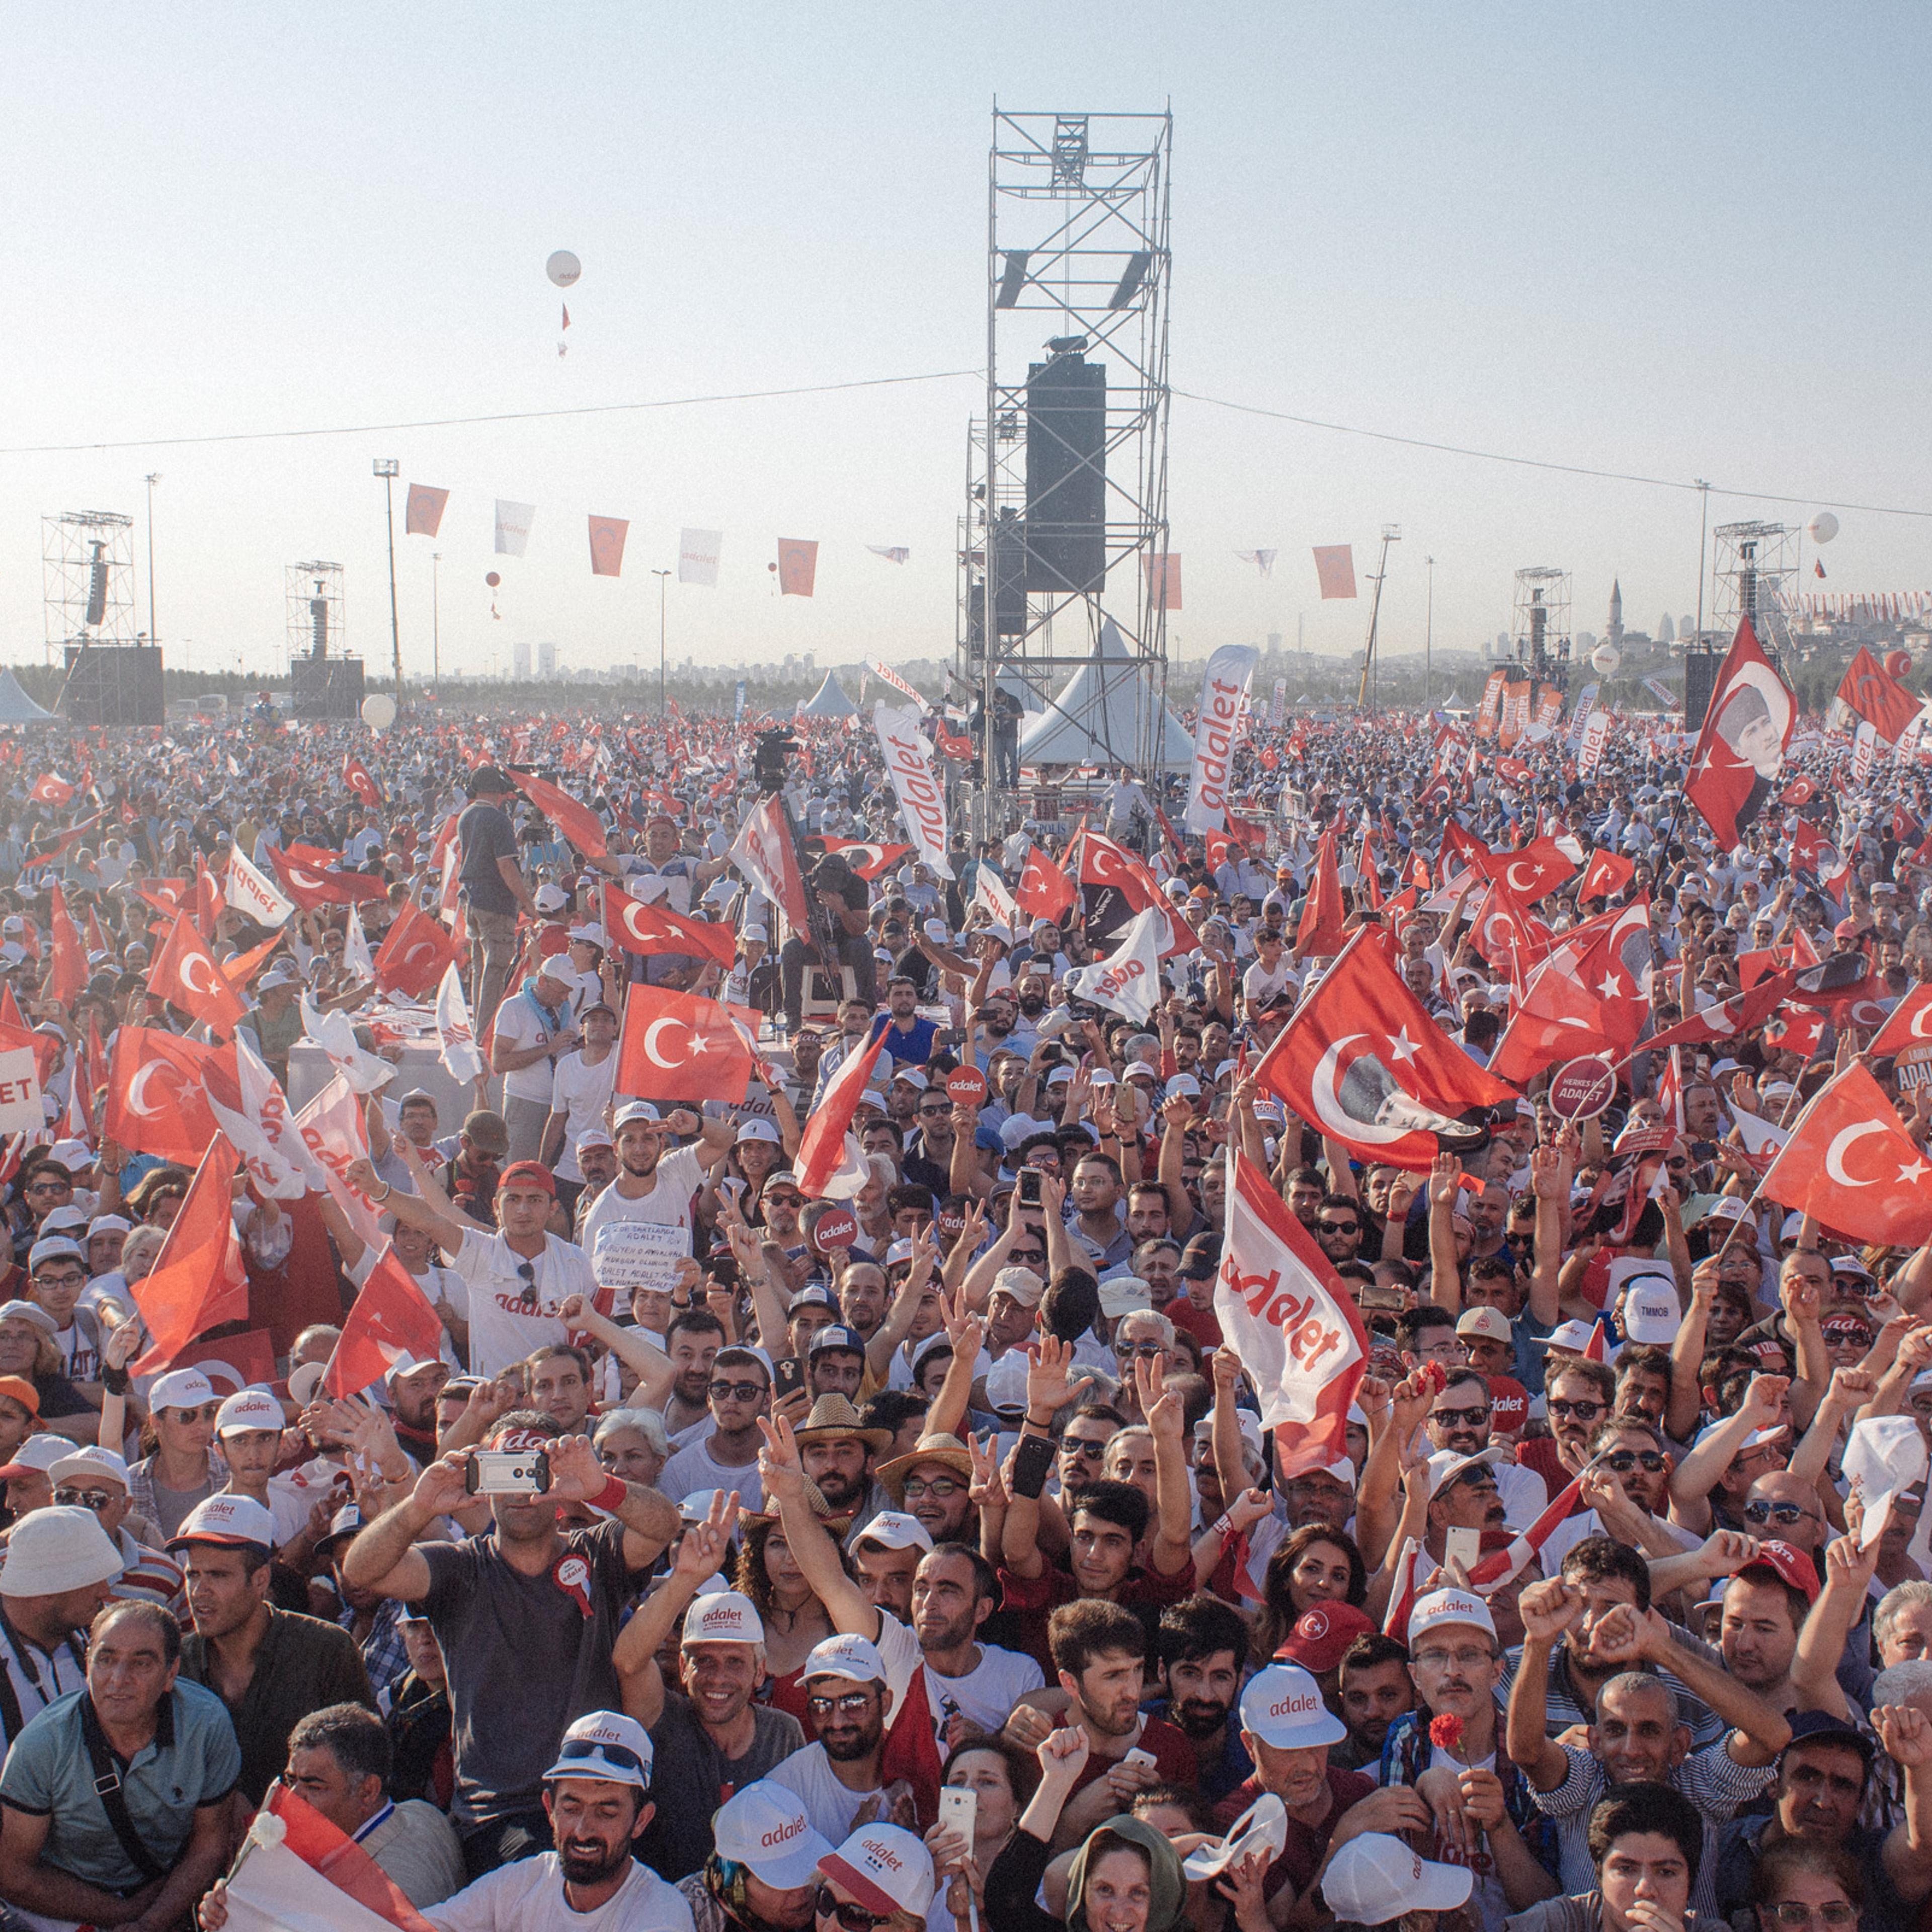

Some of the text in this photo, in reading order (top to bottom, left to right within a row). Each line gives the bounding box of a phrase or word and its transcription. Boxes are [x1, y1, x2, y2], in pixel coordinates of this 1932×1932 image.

[1482, 679, 1502, 717] adalet
[1572, 694, 1594, 740] adalet
[1578, 726, 1603, 772] dalet
[949, 1080, 983, 1092] adalet
[1562, 1078, 1591, 1087] HERKES
[820, 1221, 853, 1240] adalet
[1220, 1254, 1341, 1372] adalet
[1641, 1306, 1669, 1317] TMMOB
[234, 1402, 271, 1413] adalet
[1490, 1395, 1524, 1412] dalet
[702, 1607, 742, 1623] adalet
[1427, 1600, 1474, 1615] adalet
[814, 1646, 854, 1659] adalet
[1269, 1694, 1318, 1718] adalet
[577, 1726, 621, 1742] adalet
[761, 1814, 807, 1847] adalet
[861, 1839, 904, 1872] adalet
